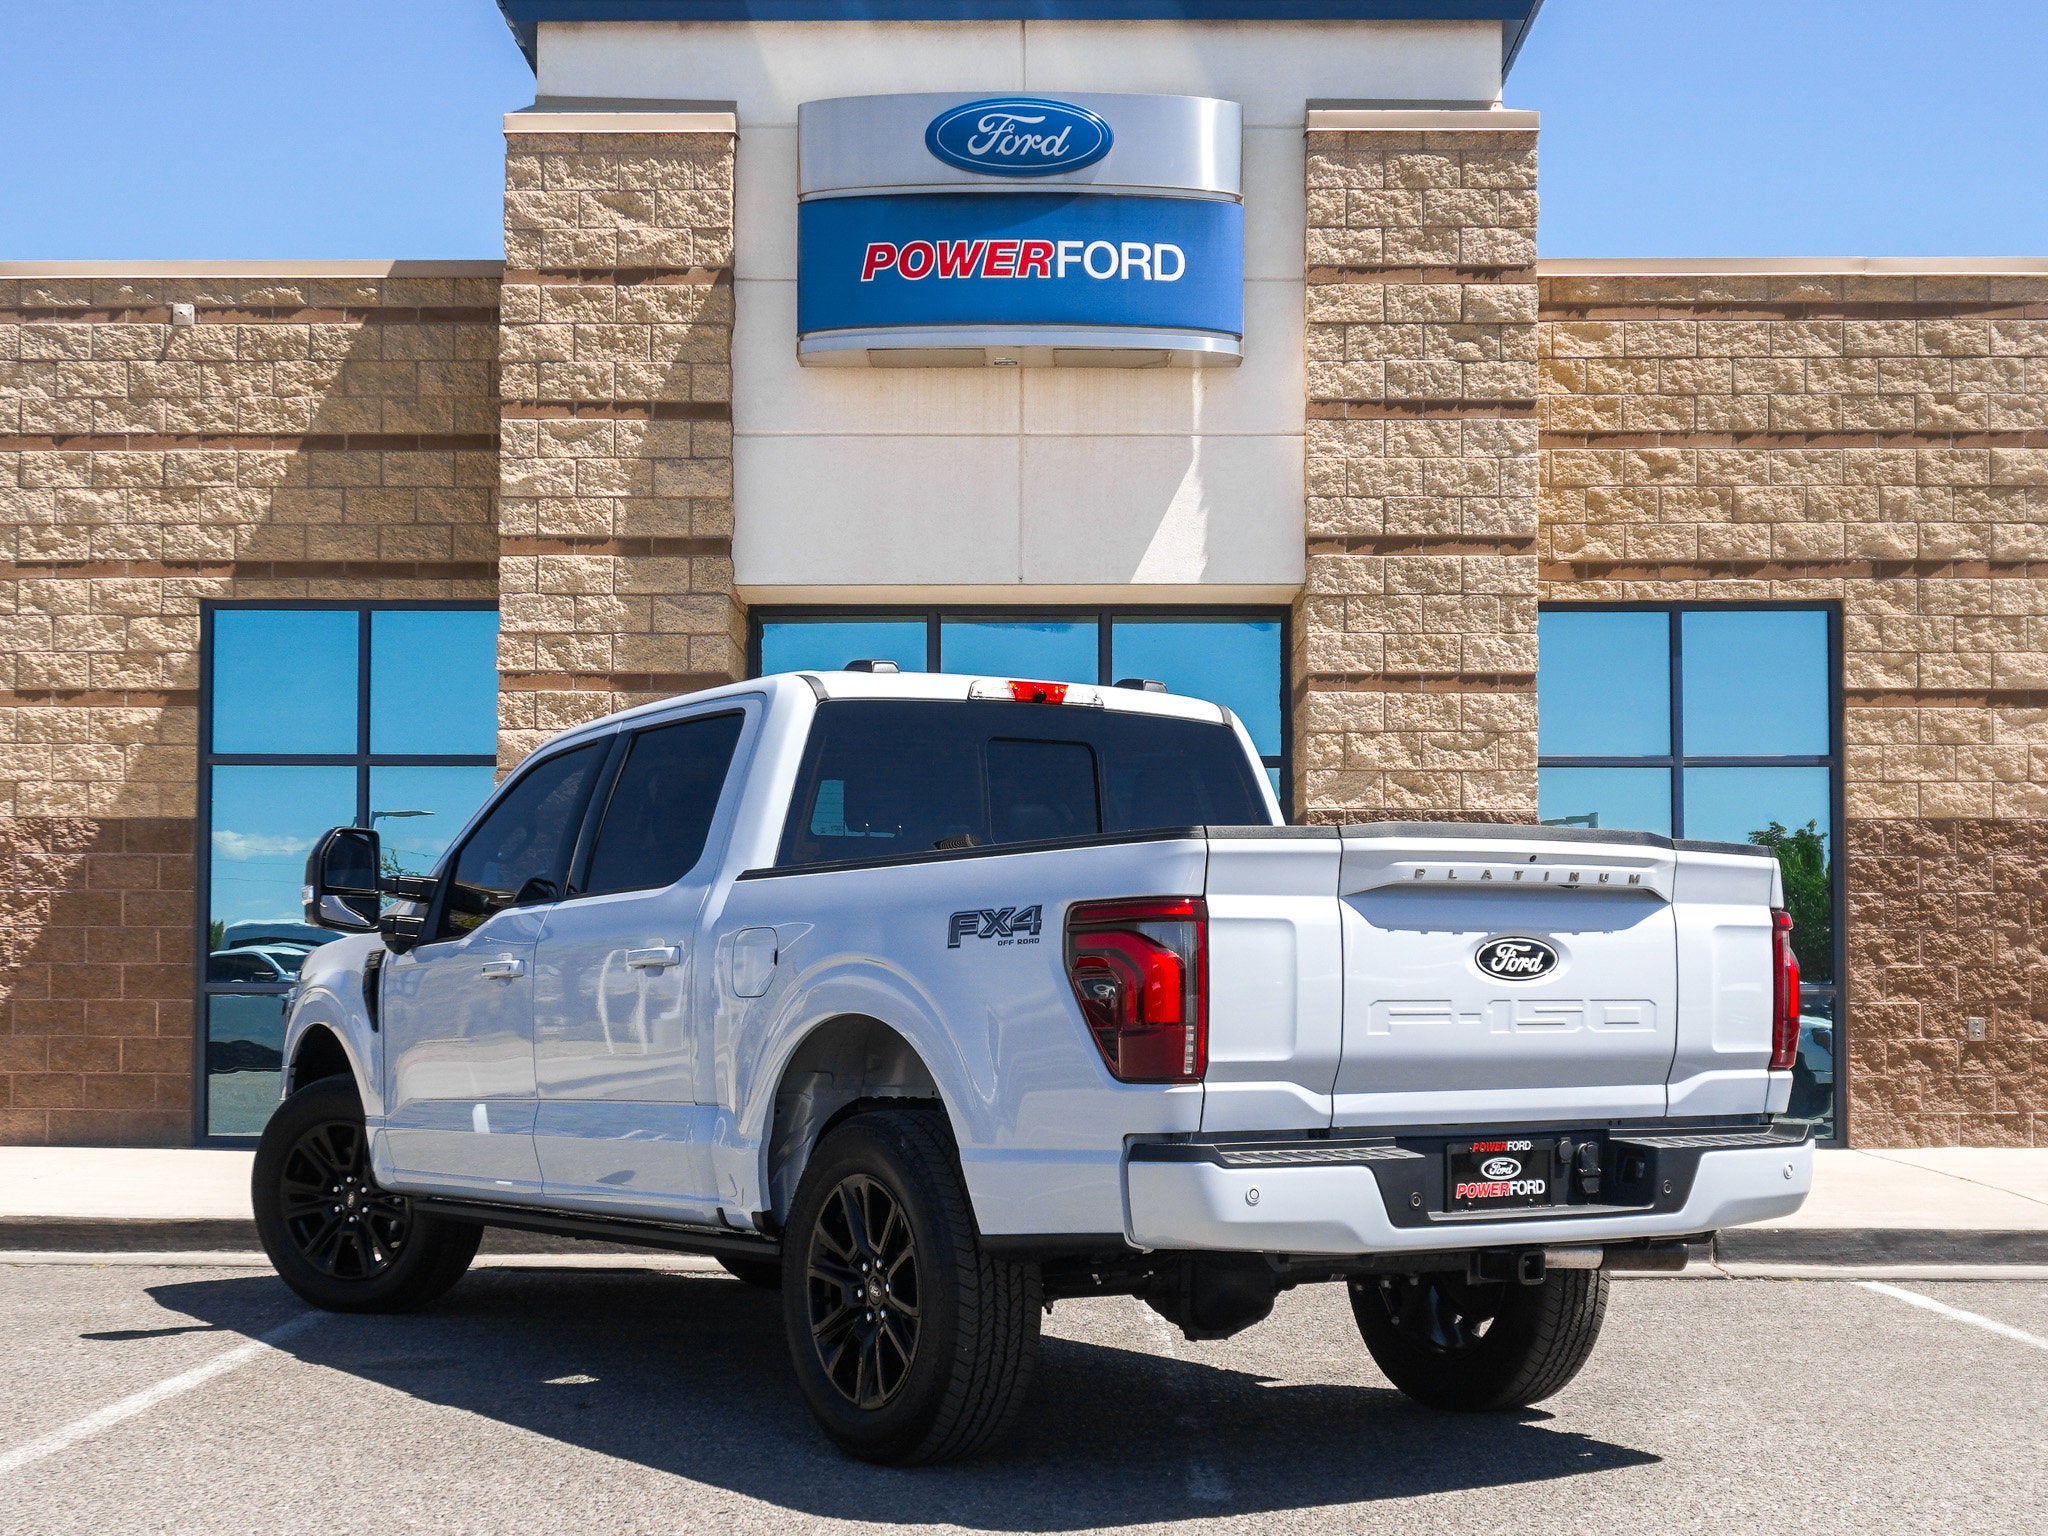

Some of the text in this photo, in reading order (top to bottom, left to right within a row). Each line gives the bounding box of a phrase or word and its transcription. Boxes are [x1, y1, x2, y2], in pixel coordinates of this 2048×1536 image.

[967, 112, 1071, 158] Ford
[1414, 868, 1642, 885] PLATINUM
[947, 905, 1042, 949] FX4
[1491, 943, 1544, 974] Ford
[1367, 999, 1657, 1035] F-150
[1489, 1161, 1513, 1176] Ford
